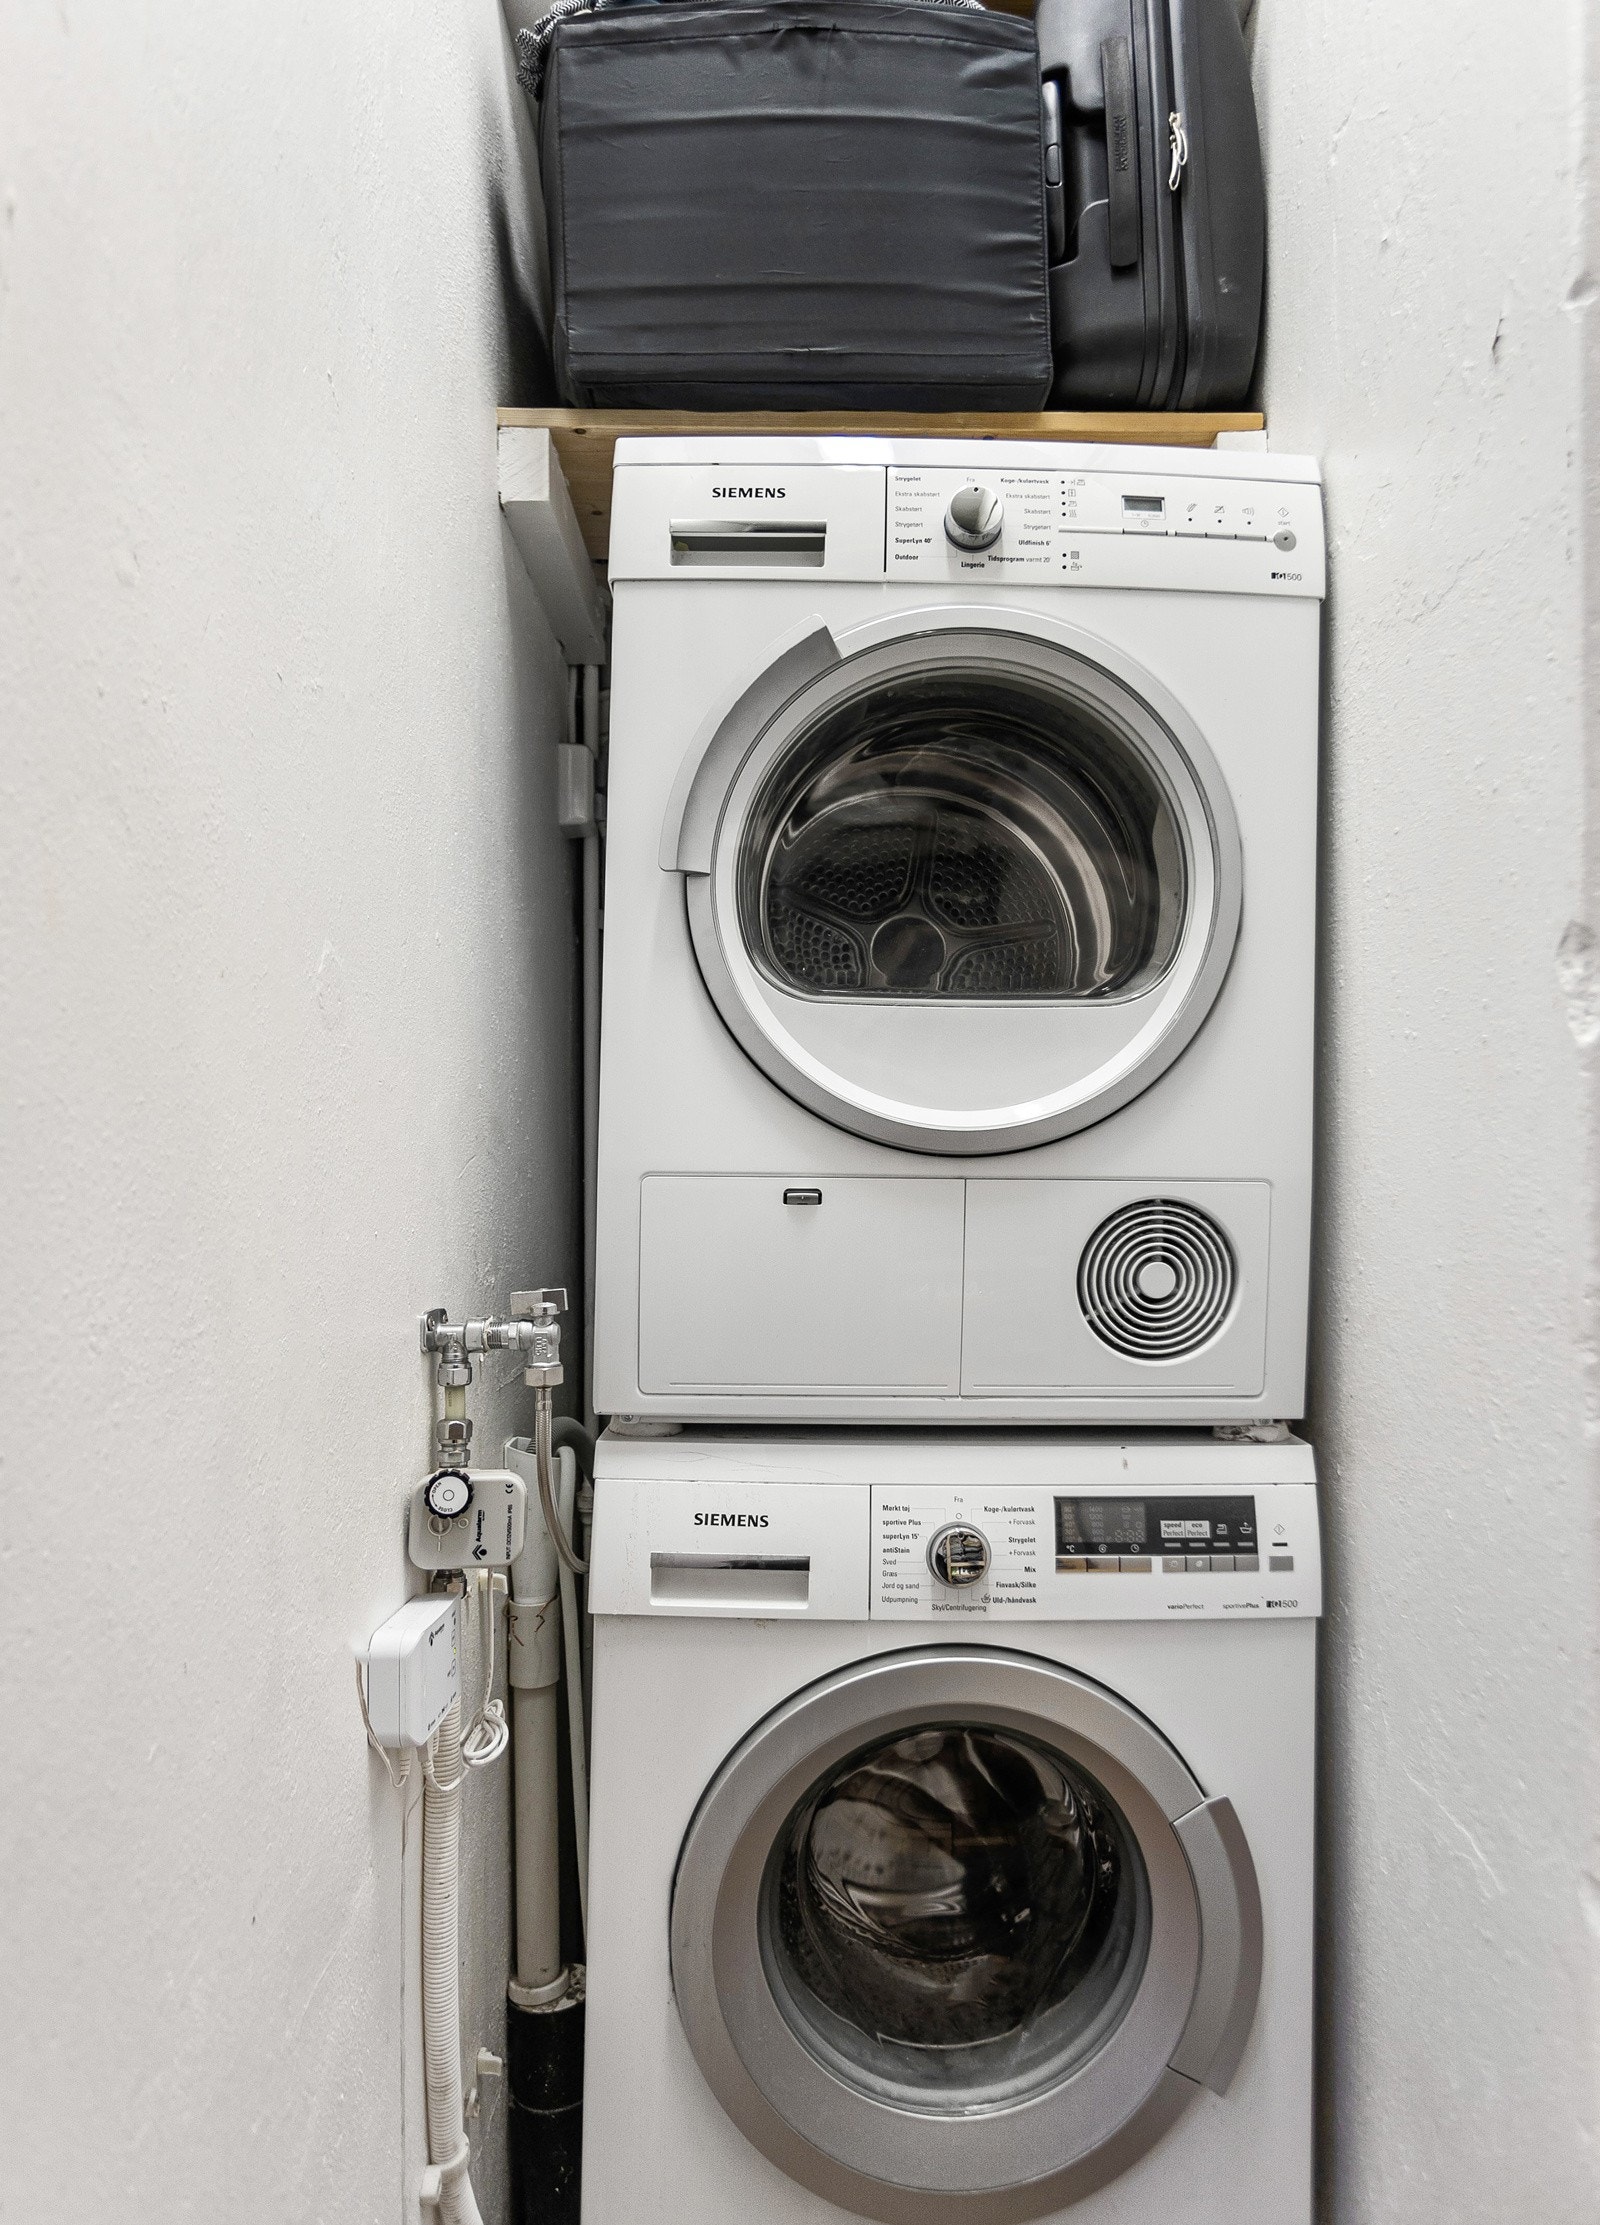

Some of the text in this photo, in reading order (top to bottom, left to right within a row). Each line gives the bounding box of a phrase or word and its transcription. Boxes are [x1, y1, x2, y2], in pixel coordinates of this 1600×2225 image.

[712, 488, 785, 498] SIEMENS
[988, 555, 1025, 563] Tidsprogram
[432, 1482, 442, 1494] OPEN
[694, 1513, 769, 1527] SIEMENS
[881, 1596, 918, 1604] Udpumpning
